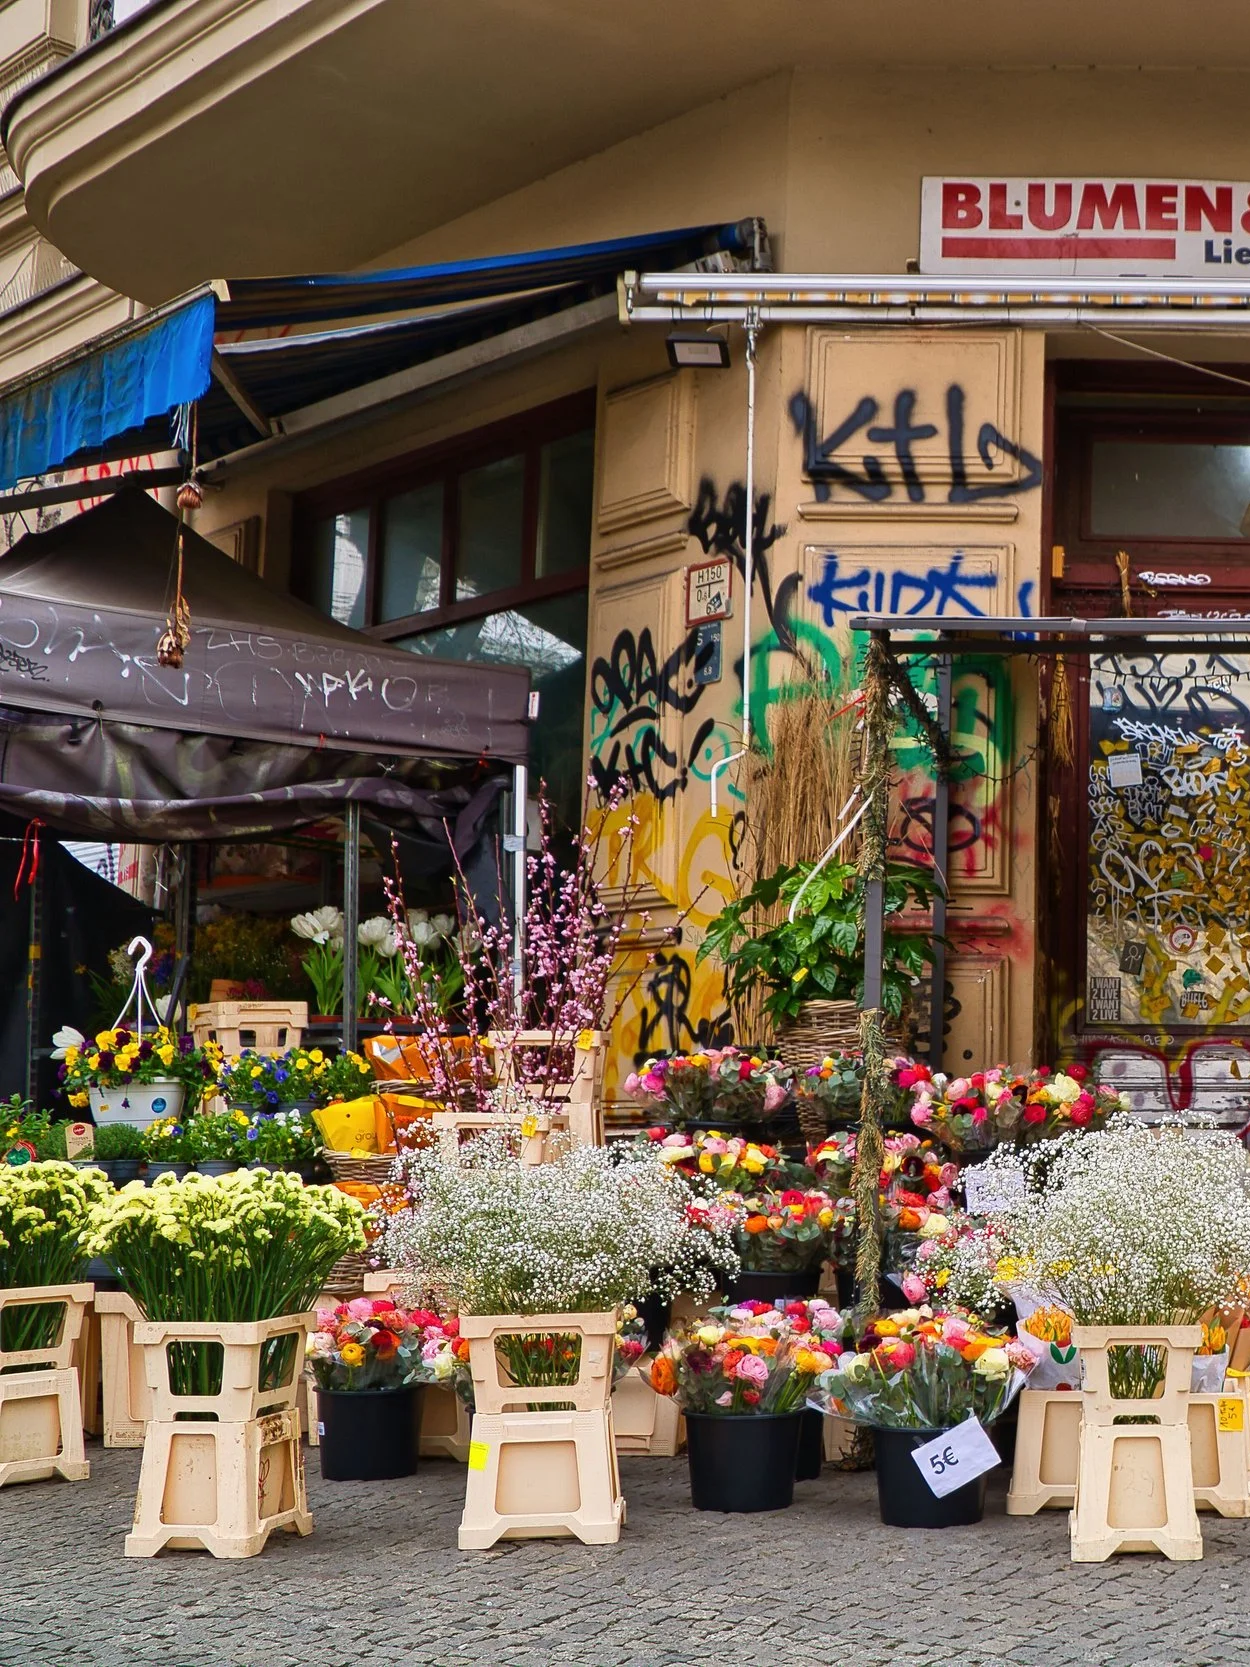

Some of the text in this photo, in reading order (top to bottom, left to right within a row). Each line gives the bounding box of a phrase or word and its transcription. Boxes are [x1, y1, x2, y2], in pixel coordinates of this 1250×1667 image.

[942, 182, 1234, 232] BLUMEN
[1096, 978, 1120, 988] WANT
[1100, 989, 1118, 998] LIVE
[1096, 1000, 1120, 1010] WANT
[1100, 1010, 1118, 1020] LIVE
[929, 1446, 959, 1475] 5€
